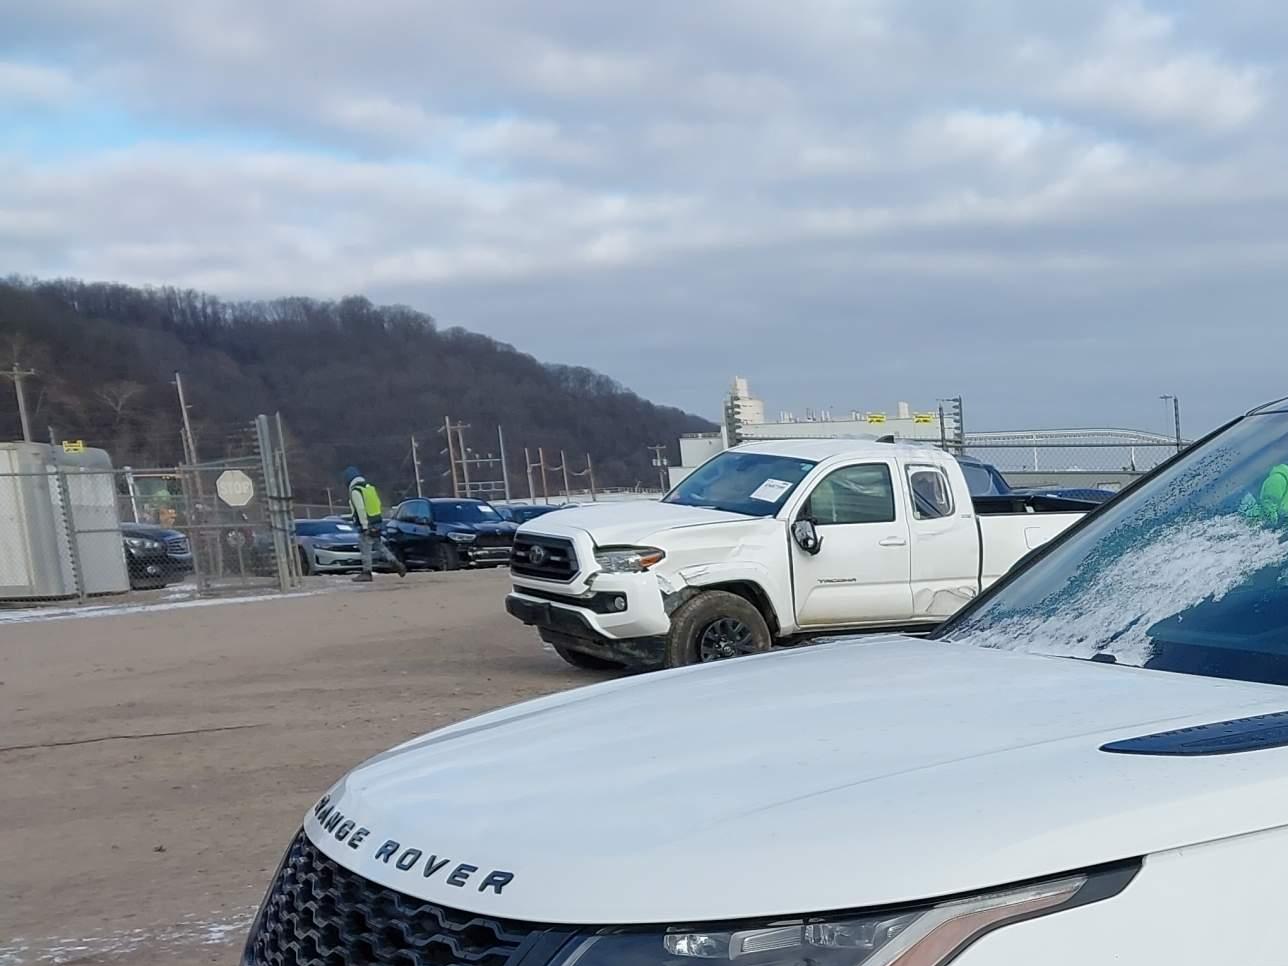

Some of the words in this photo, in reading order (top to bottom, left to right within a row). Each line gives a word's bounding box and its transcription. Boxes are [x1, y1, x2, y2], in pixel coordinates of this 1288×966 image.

[219, 480, 250, 495] STOP
[314, 794, 370, 850] RANGE
[374, 839, 515, 895] ROVER
